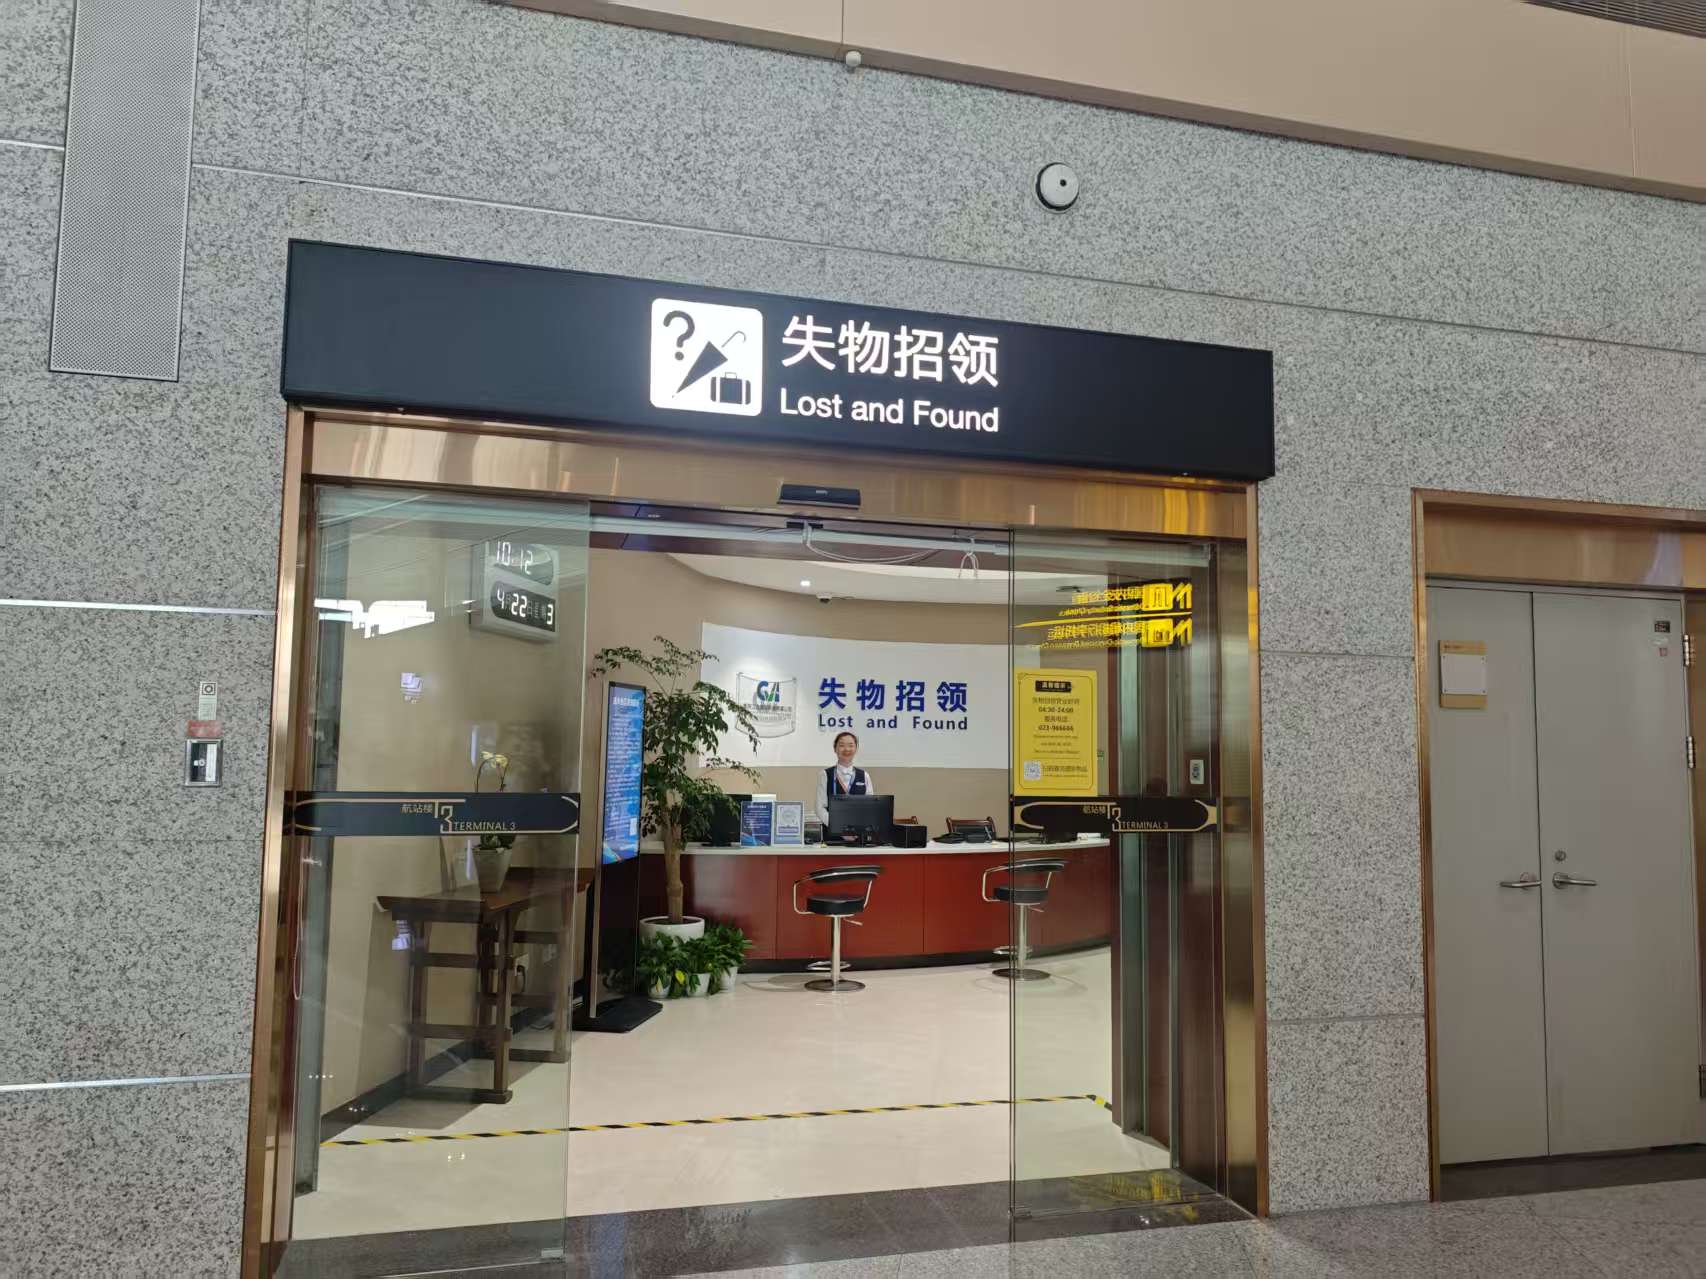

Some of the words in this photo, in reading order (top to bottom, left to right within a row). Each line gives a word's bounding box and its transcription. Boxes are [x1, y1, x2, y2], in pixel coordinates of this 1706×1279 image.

[781, 314, 999, 388] 失物招领
[780, 388, 843, 420] Lost
[851, 398, 904, 425] and
[913, 400, 999, 433] Found
[511, 593, 528, 617] 22
[546, 603, 554, 625] 3
[818, 677, 968, 713] 失物招领
[818, 714, 853, 728] Lost
[866, 715, 898, 729] and
[912, 716, 968, 730] Found
[454, 821, 507, 831] TERMINAL
[510, 821, 516, 831] 3
[1122, 821, 1162, 829] TERMINAL
